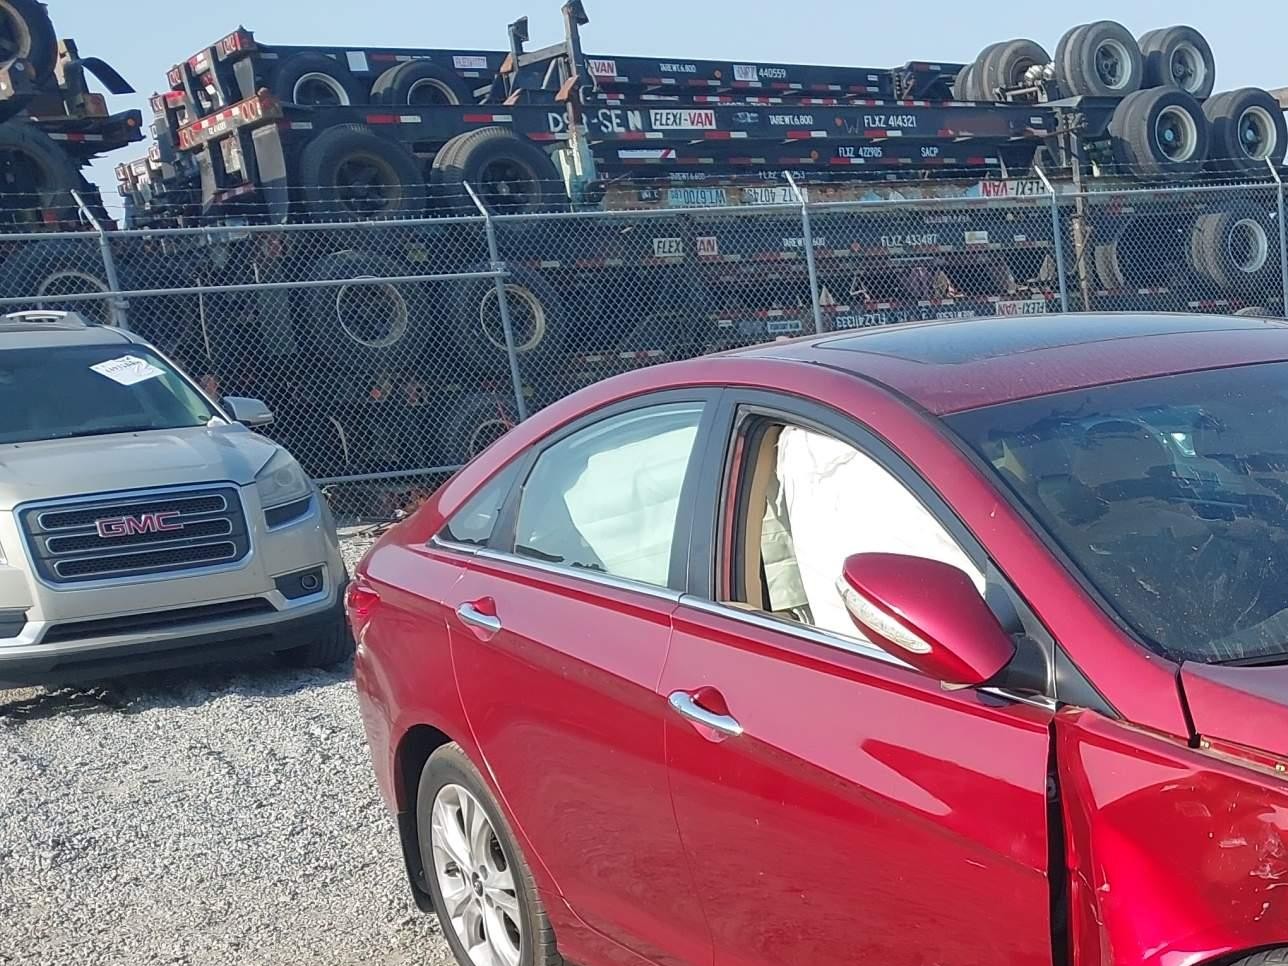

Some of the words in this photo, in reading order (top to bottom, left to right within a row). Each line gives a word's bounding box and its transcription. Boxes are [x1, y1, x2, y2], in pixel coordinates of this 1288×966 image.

[653, 111, 714, 127] FLEXI-VAN
[864, 115, 887, 127] FLXZ
[888, 116, 917, 127] 414321
[838, 147, 855, 157] FLXZ
[998, 302, 1044, 316] FLEXI-VAN
[95, 511, 184, 538] GMC
